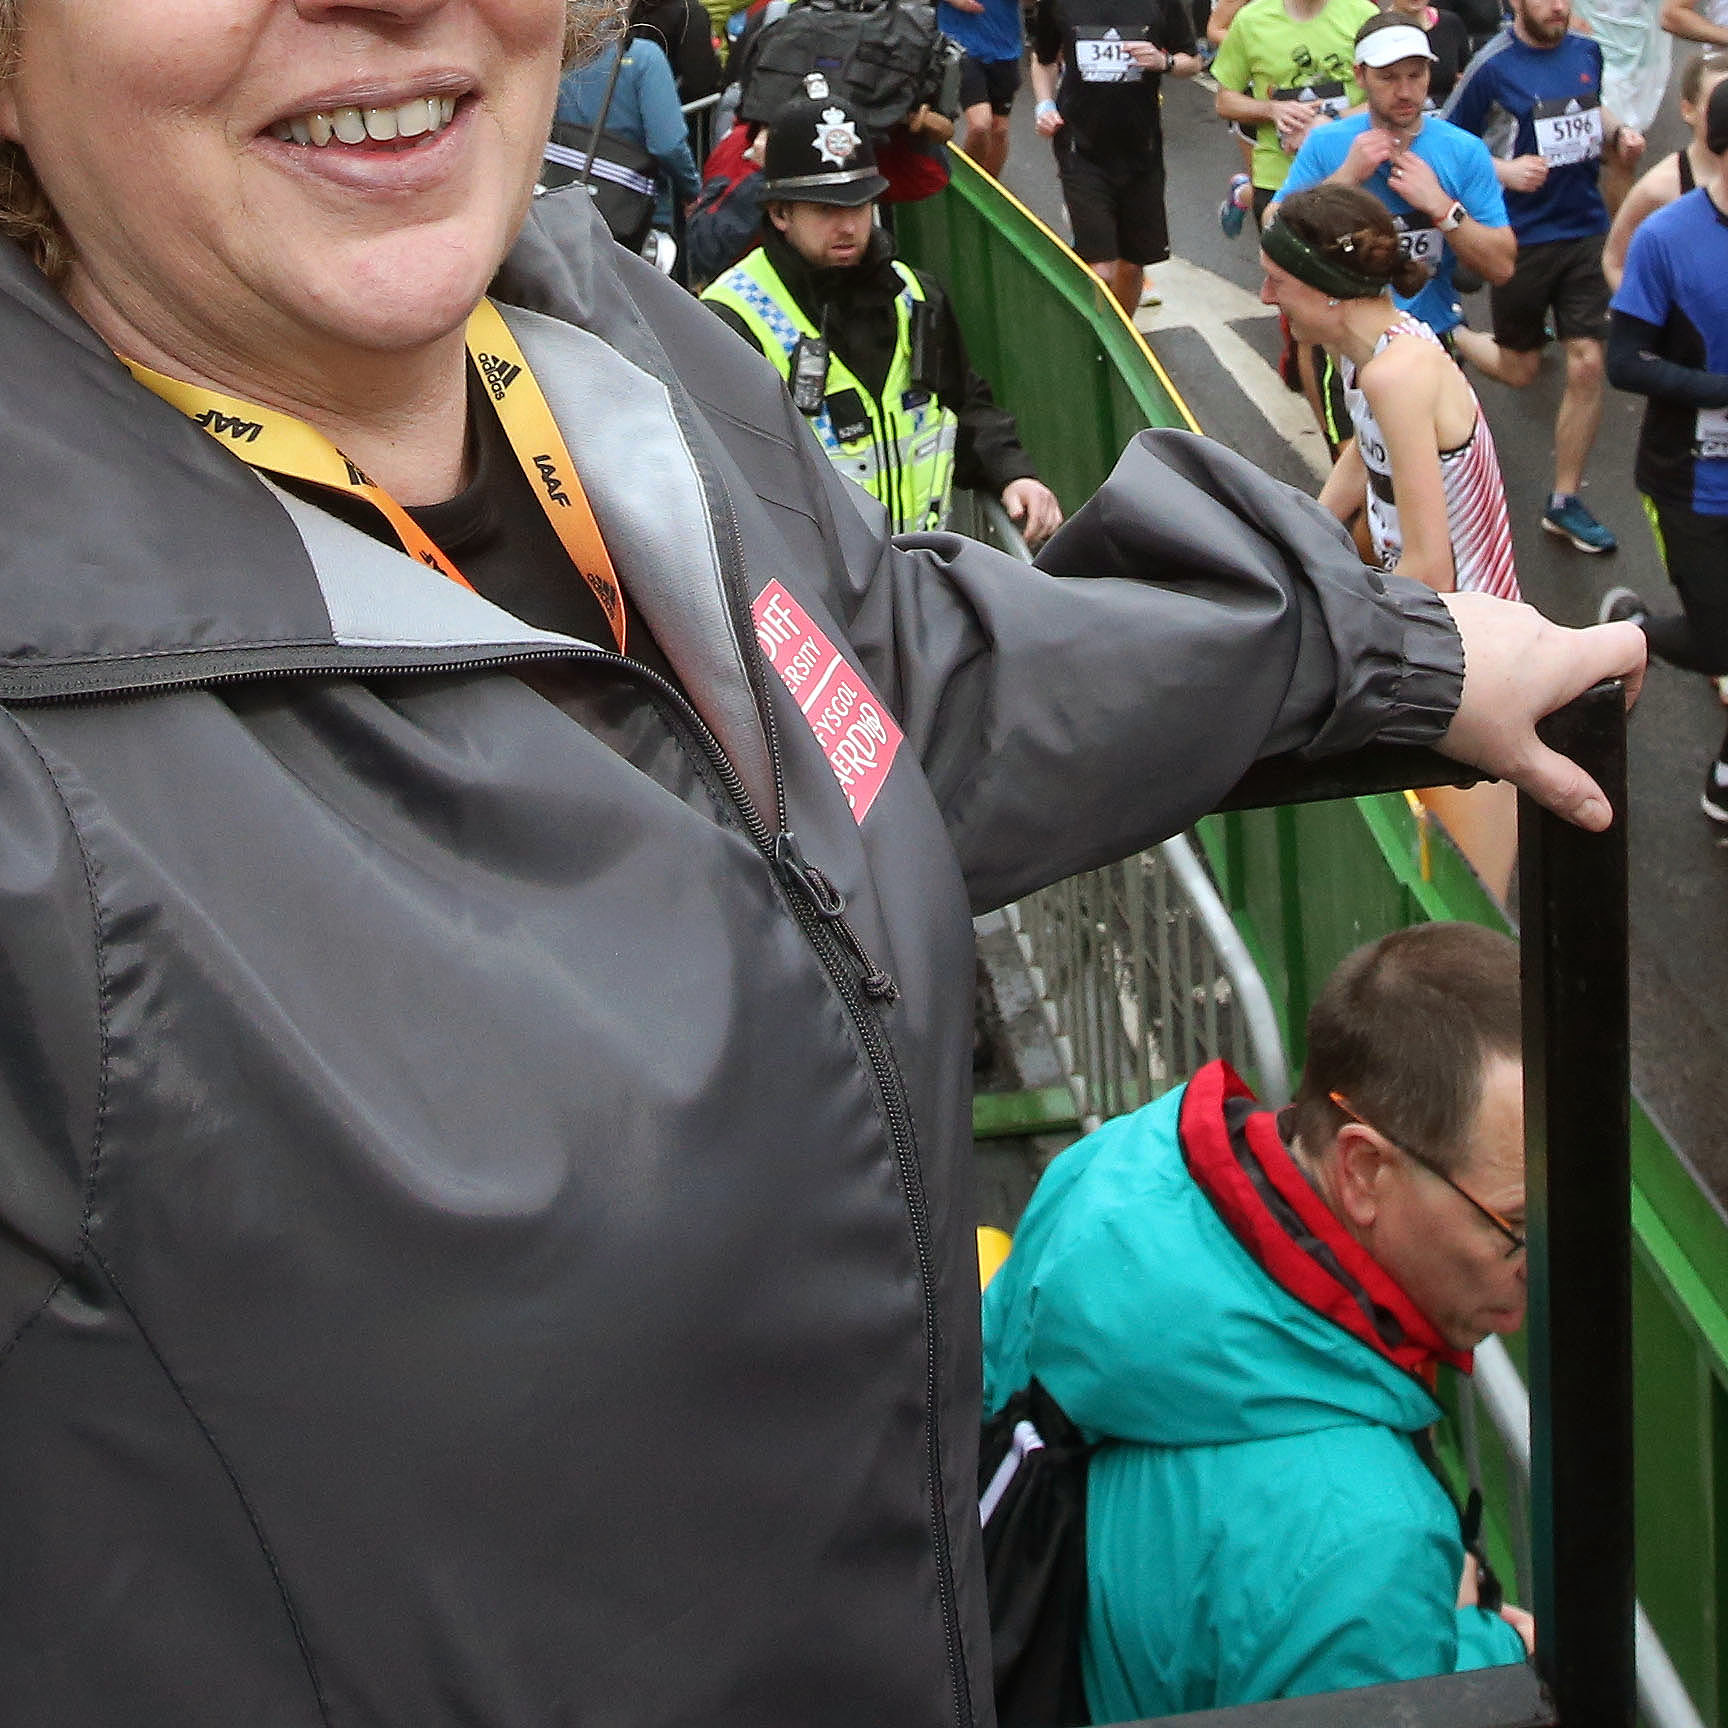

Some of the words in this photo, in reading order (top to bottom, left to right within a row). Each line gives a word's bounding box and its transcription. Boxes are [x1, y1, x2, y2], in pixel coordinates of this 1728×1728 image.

[1554, 115, 1592, 141] 5196
[478, 353, 506, 401] adidas
[191, 409, 263, 443] IAAF
[532, 454, 572, 508] IAAF
